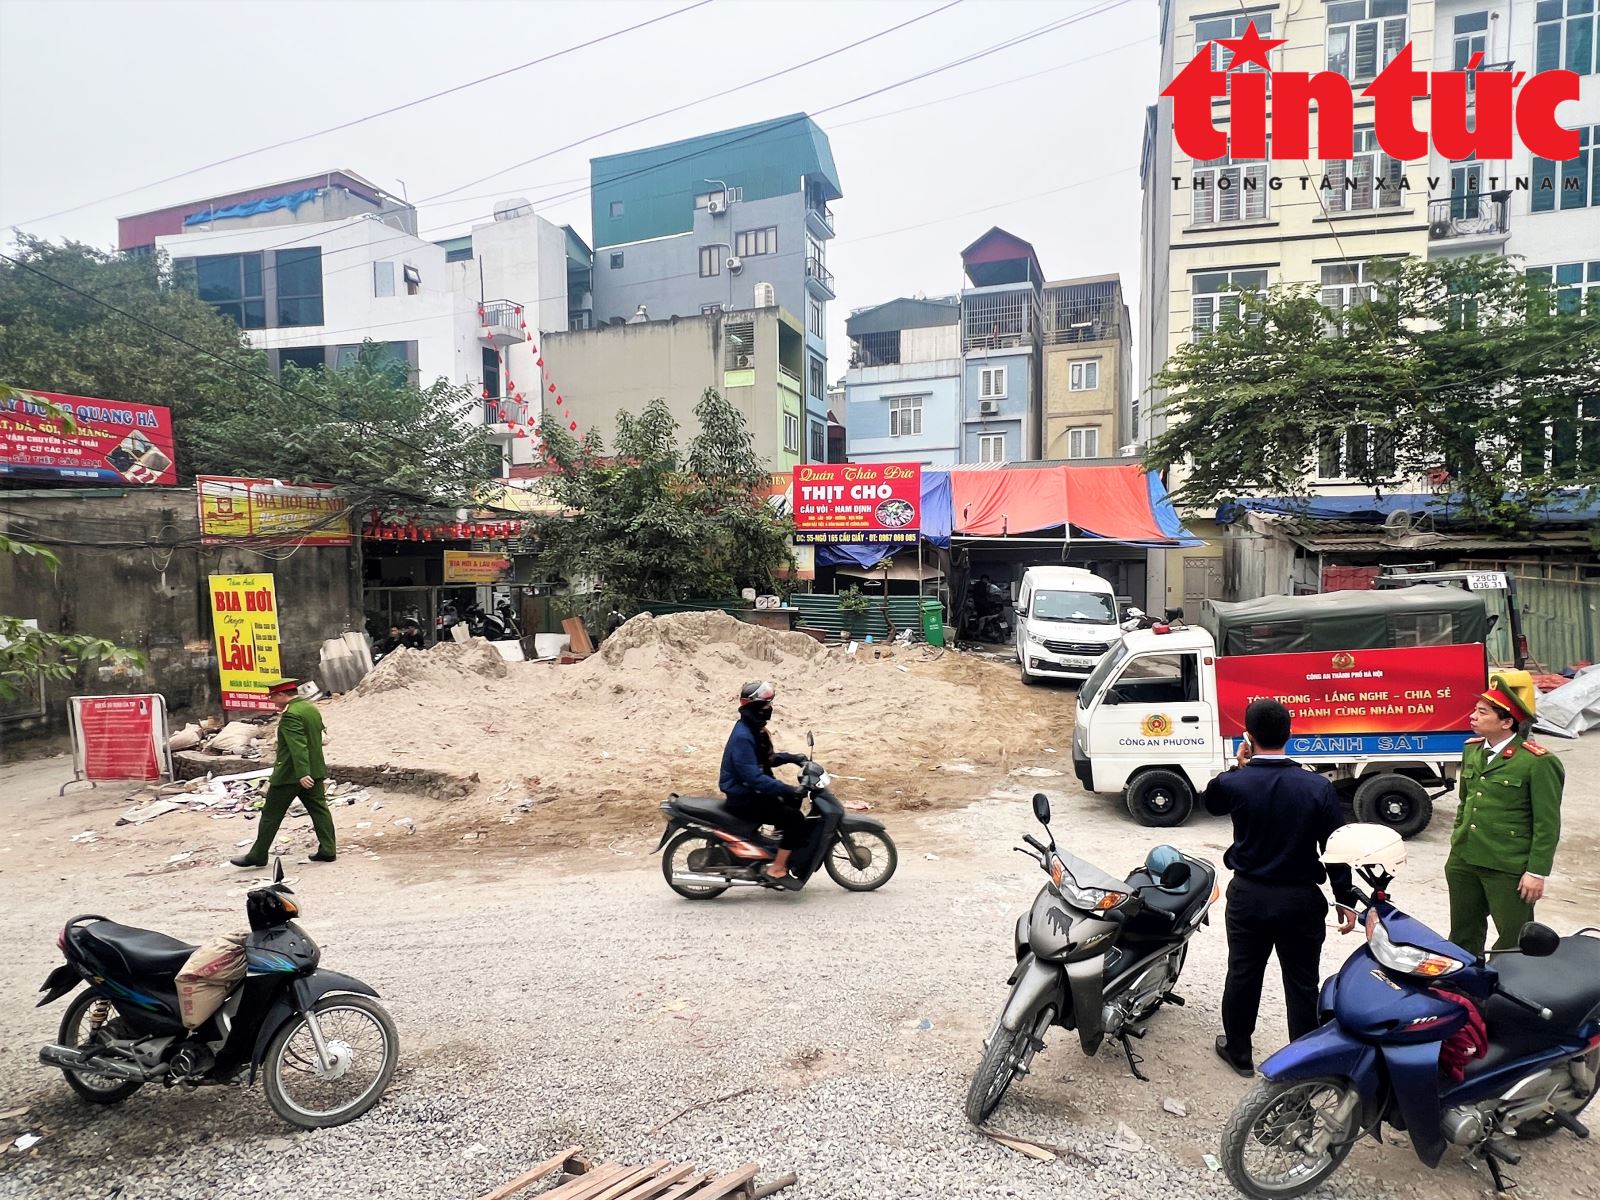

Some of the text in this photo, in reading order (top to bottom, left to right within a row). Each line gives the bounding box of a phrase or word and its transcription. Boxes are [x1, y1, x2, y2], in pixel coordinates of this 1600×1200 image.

[77, 405, 133, 424] QUANG
[799, 467, 834, 482] Quán
[883, 465, 915, 480] Đức
[801, 481, 893, 503] THỊT CHÓ
[834, 505, 852, 514] NAM
[214, 586, 273, 612] BIA HƠI
[219, 628, 254, 672] Lẩu
[1359, 691, 1389, 701] NGHE
[1404, 689, 1432, 699] CHIA
[1437, 686, 1451, 698] SẺ
[1300, 706, 1331, 718] HÀNH
[1335, 705, 1367, 716] CÙNG
[1370, 703, 1404, 715] NHÂN
[1408, 703, 1434, 714] DÂN
[1119, 736, 1205, 747] CÔNG AN PHƯỜNG
